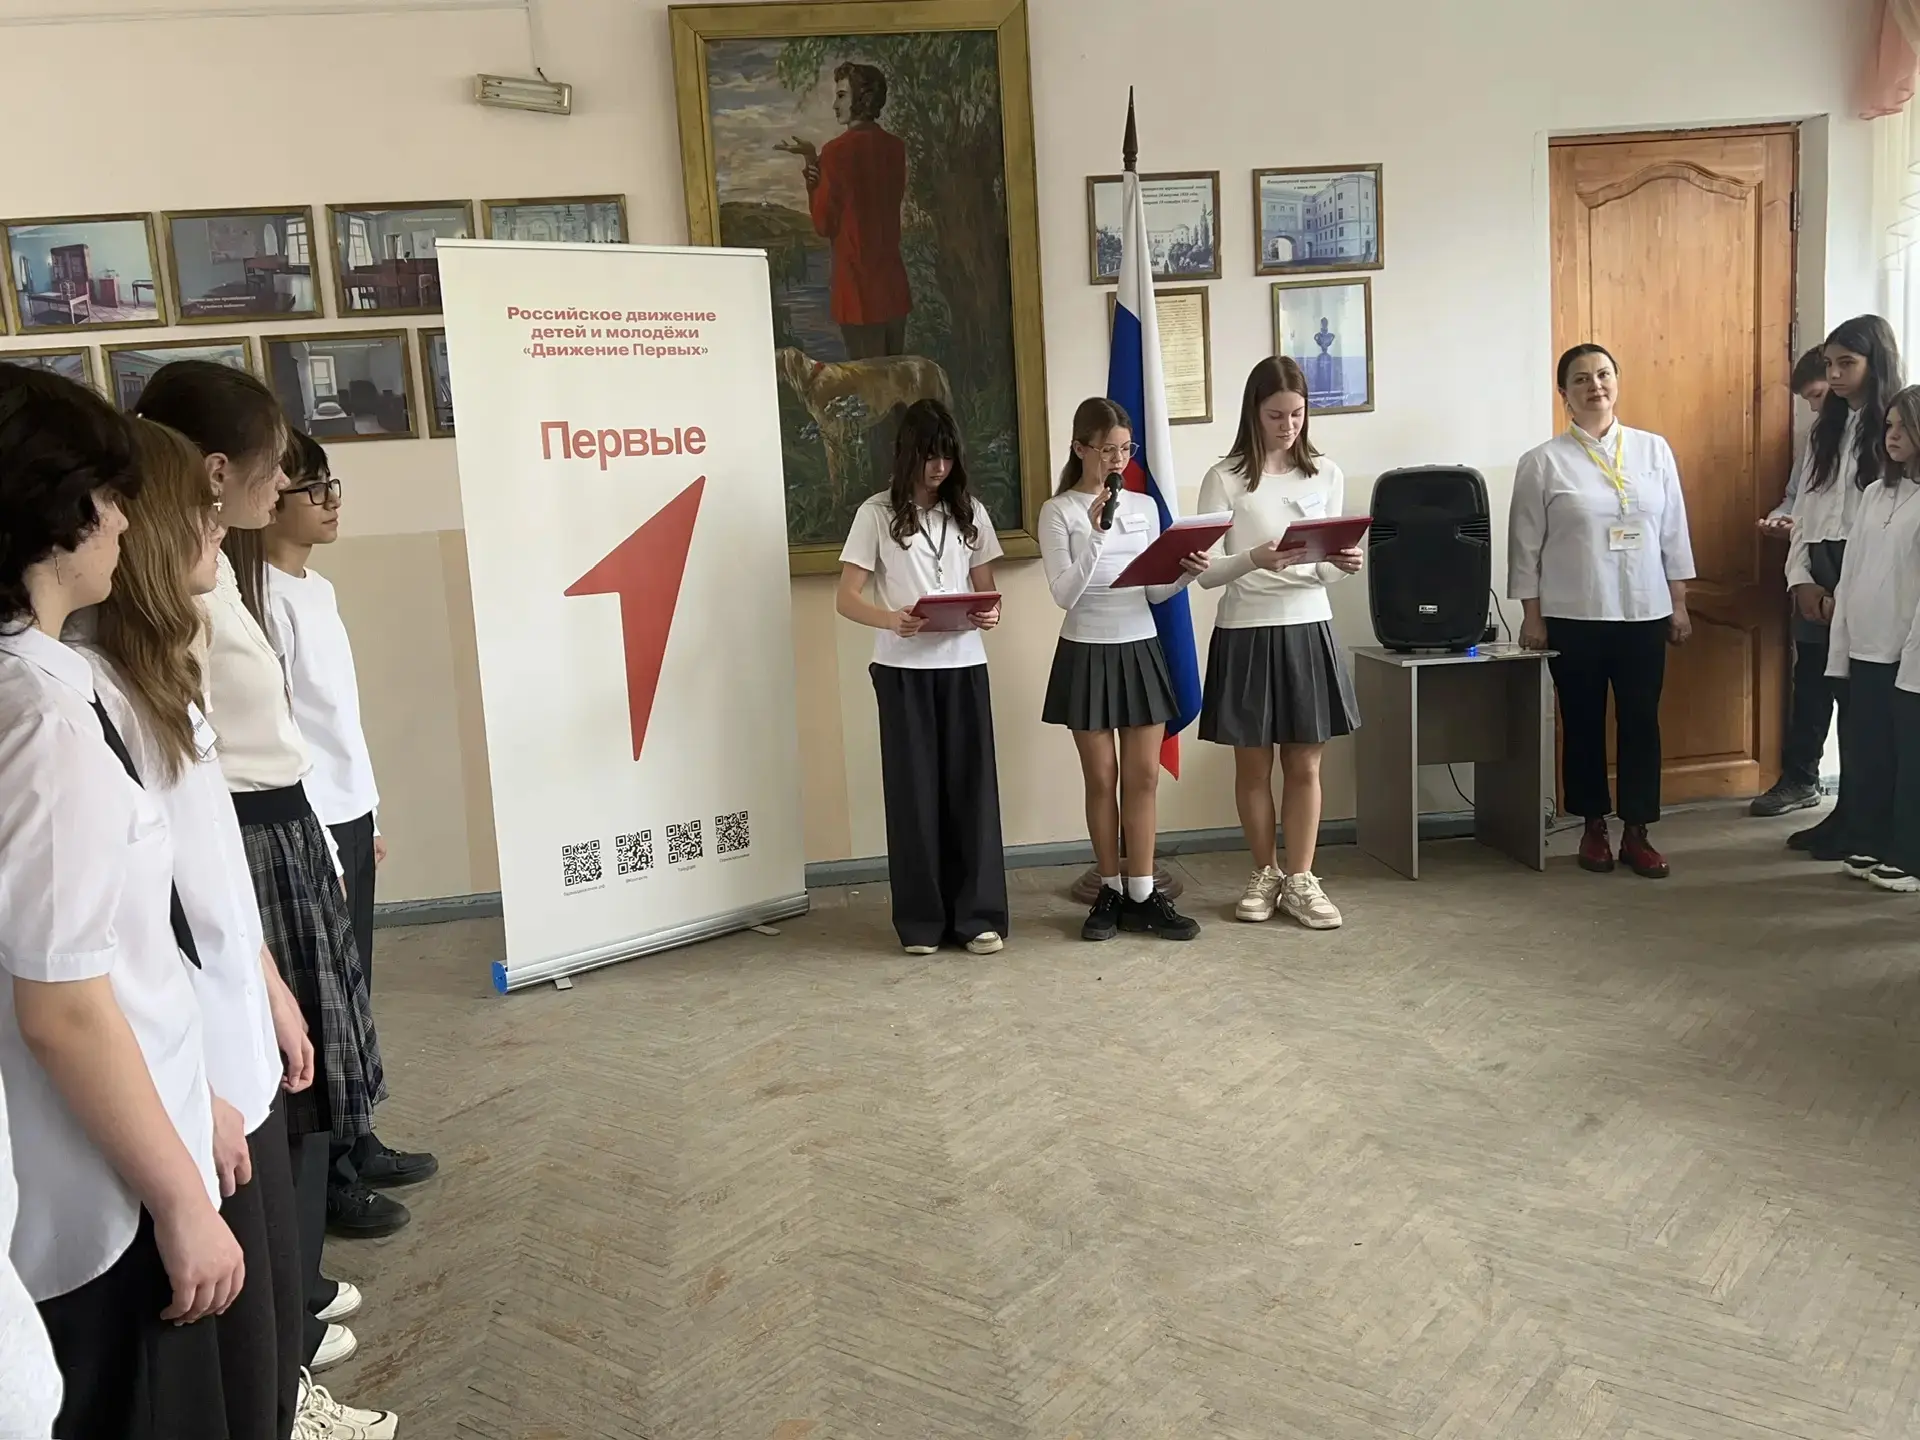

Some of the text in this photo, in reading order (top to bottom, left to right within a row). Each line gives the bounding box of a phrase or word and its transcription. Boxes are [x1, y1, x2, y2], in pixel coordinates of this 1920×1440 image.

[507, 306, 717, 322] Российское движение
[531, 325, 699, 340] детей и молодёжи
[523, 343, 709, 358] «Движение Первых»
[540, 421, 706, 471] Первые
